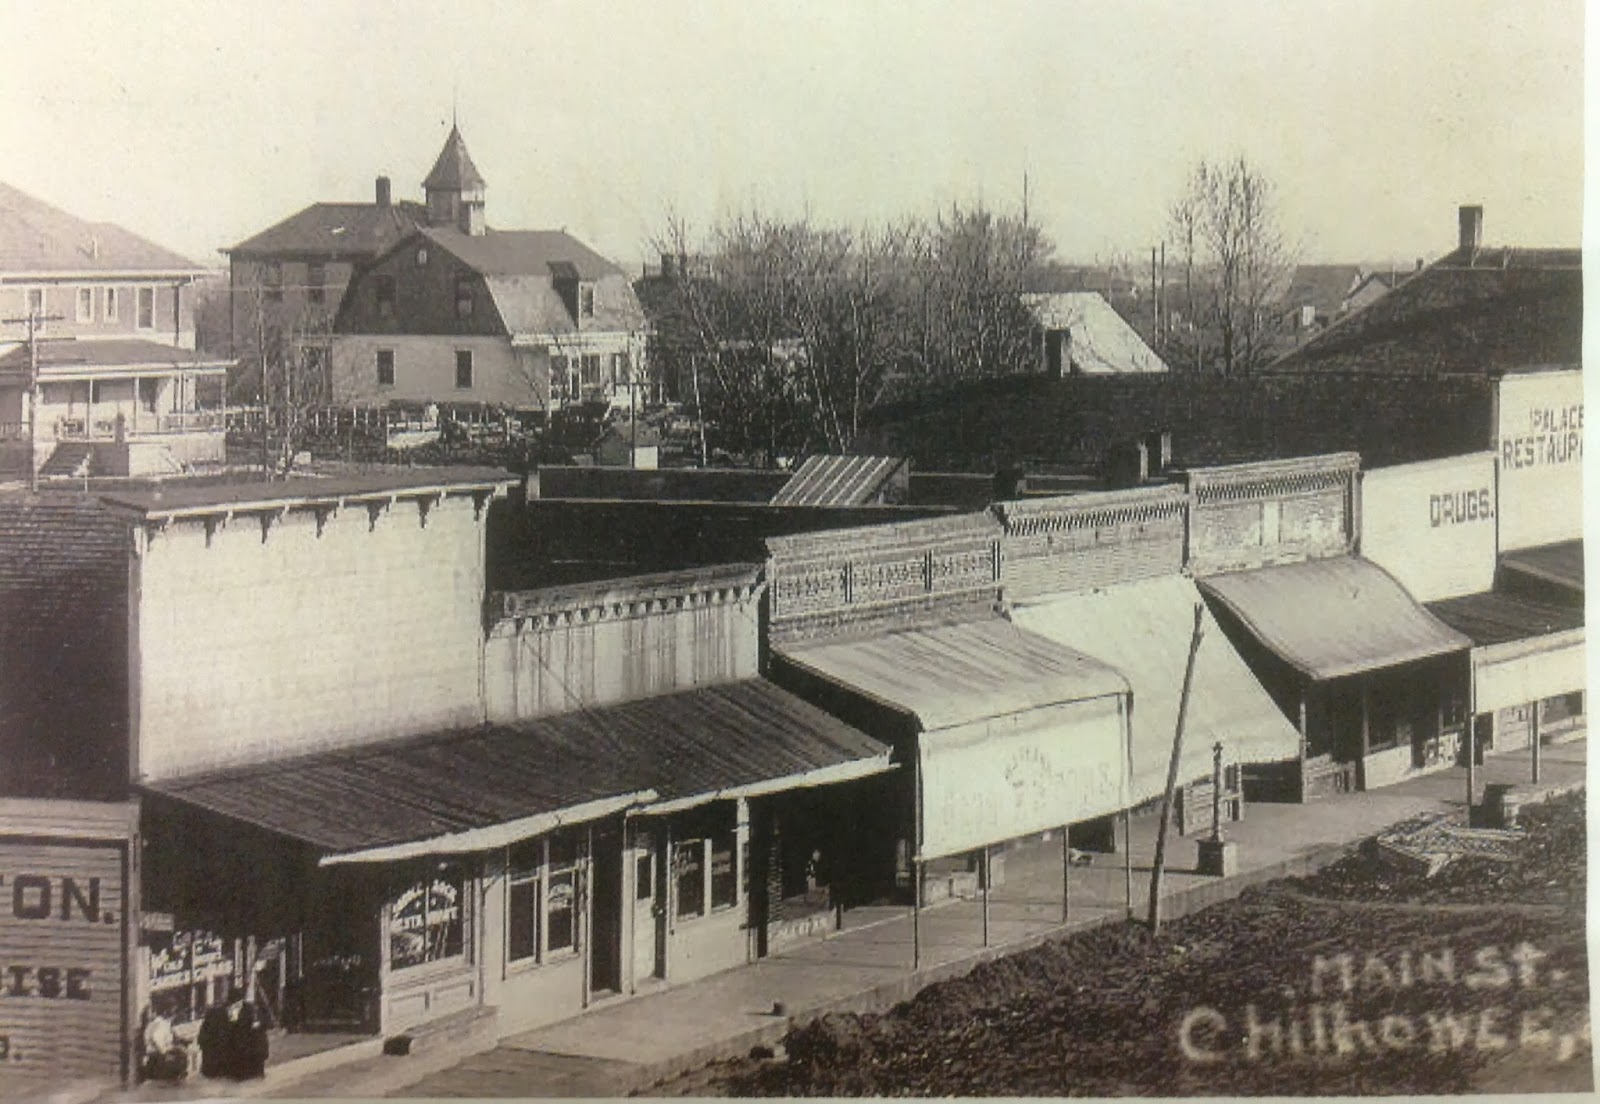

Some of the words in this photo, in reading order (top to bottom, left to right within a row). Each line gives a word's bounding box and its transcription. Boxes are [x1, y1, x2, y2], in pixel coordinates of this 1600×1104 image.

[1503, 431, 1584, 470] RESTAUR
[1429, 488, 1494, 528] DRUGS.
[0, 874, 114, 925] ON.
